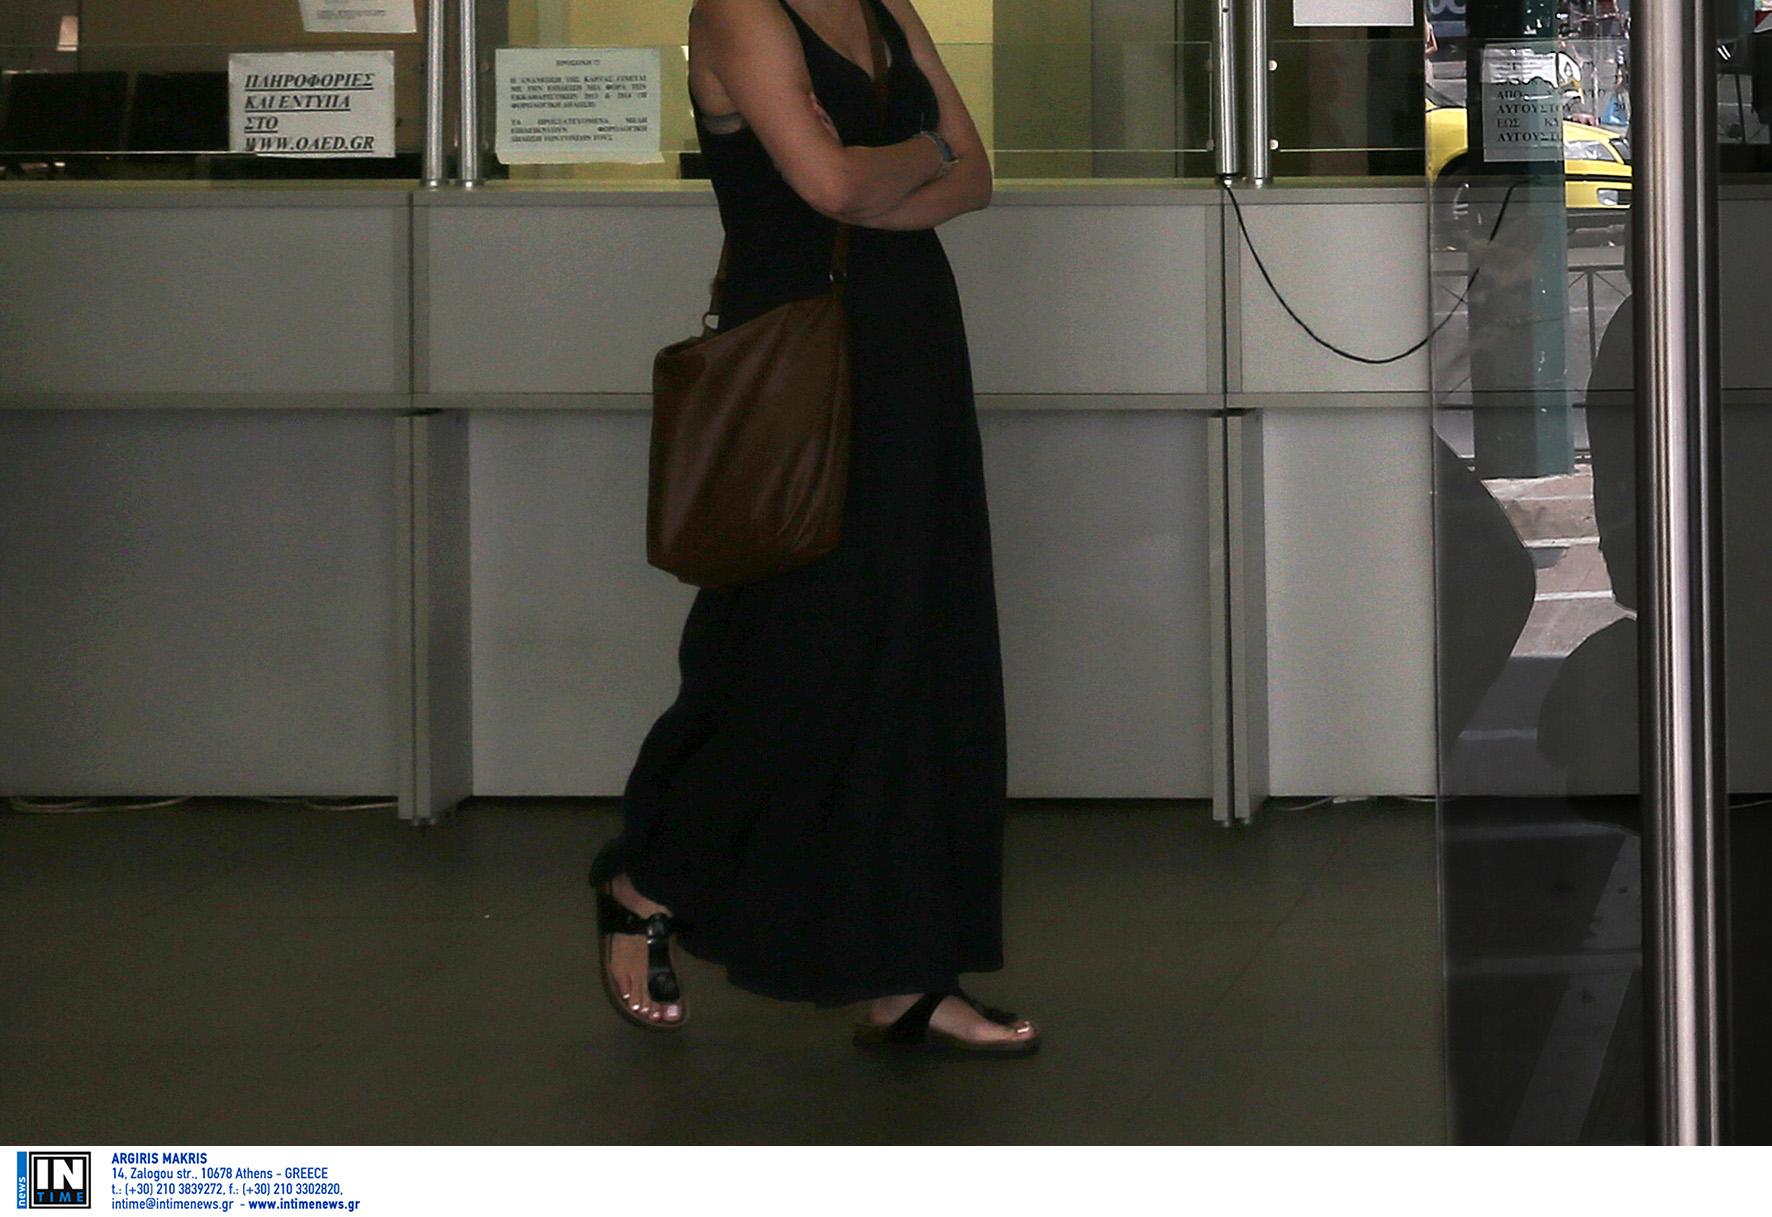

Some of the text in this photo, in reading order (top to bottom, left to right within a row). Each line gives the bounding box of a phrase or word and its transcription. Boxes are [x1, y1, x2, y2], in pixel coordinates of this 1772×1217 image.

[244, 72, 375, 89] ΠΛΗΡΟΦΟΡΙΕΣ
[244, 95, 351, 110] ΚΑΙ ΕΝΤΥΠΑ
[244, 116, 279, 131] ΣΤΟ
[244, 135, 376, 152] WWW.OAED.GR
